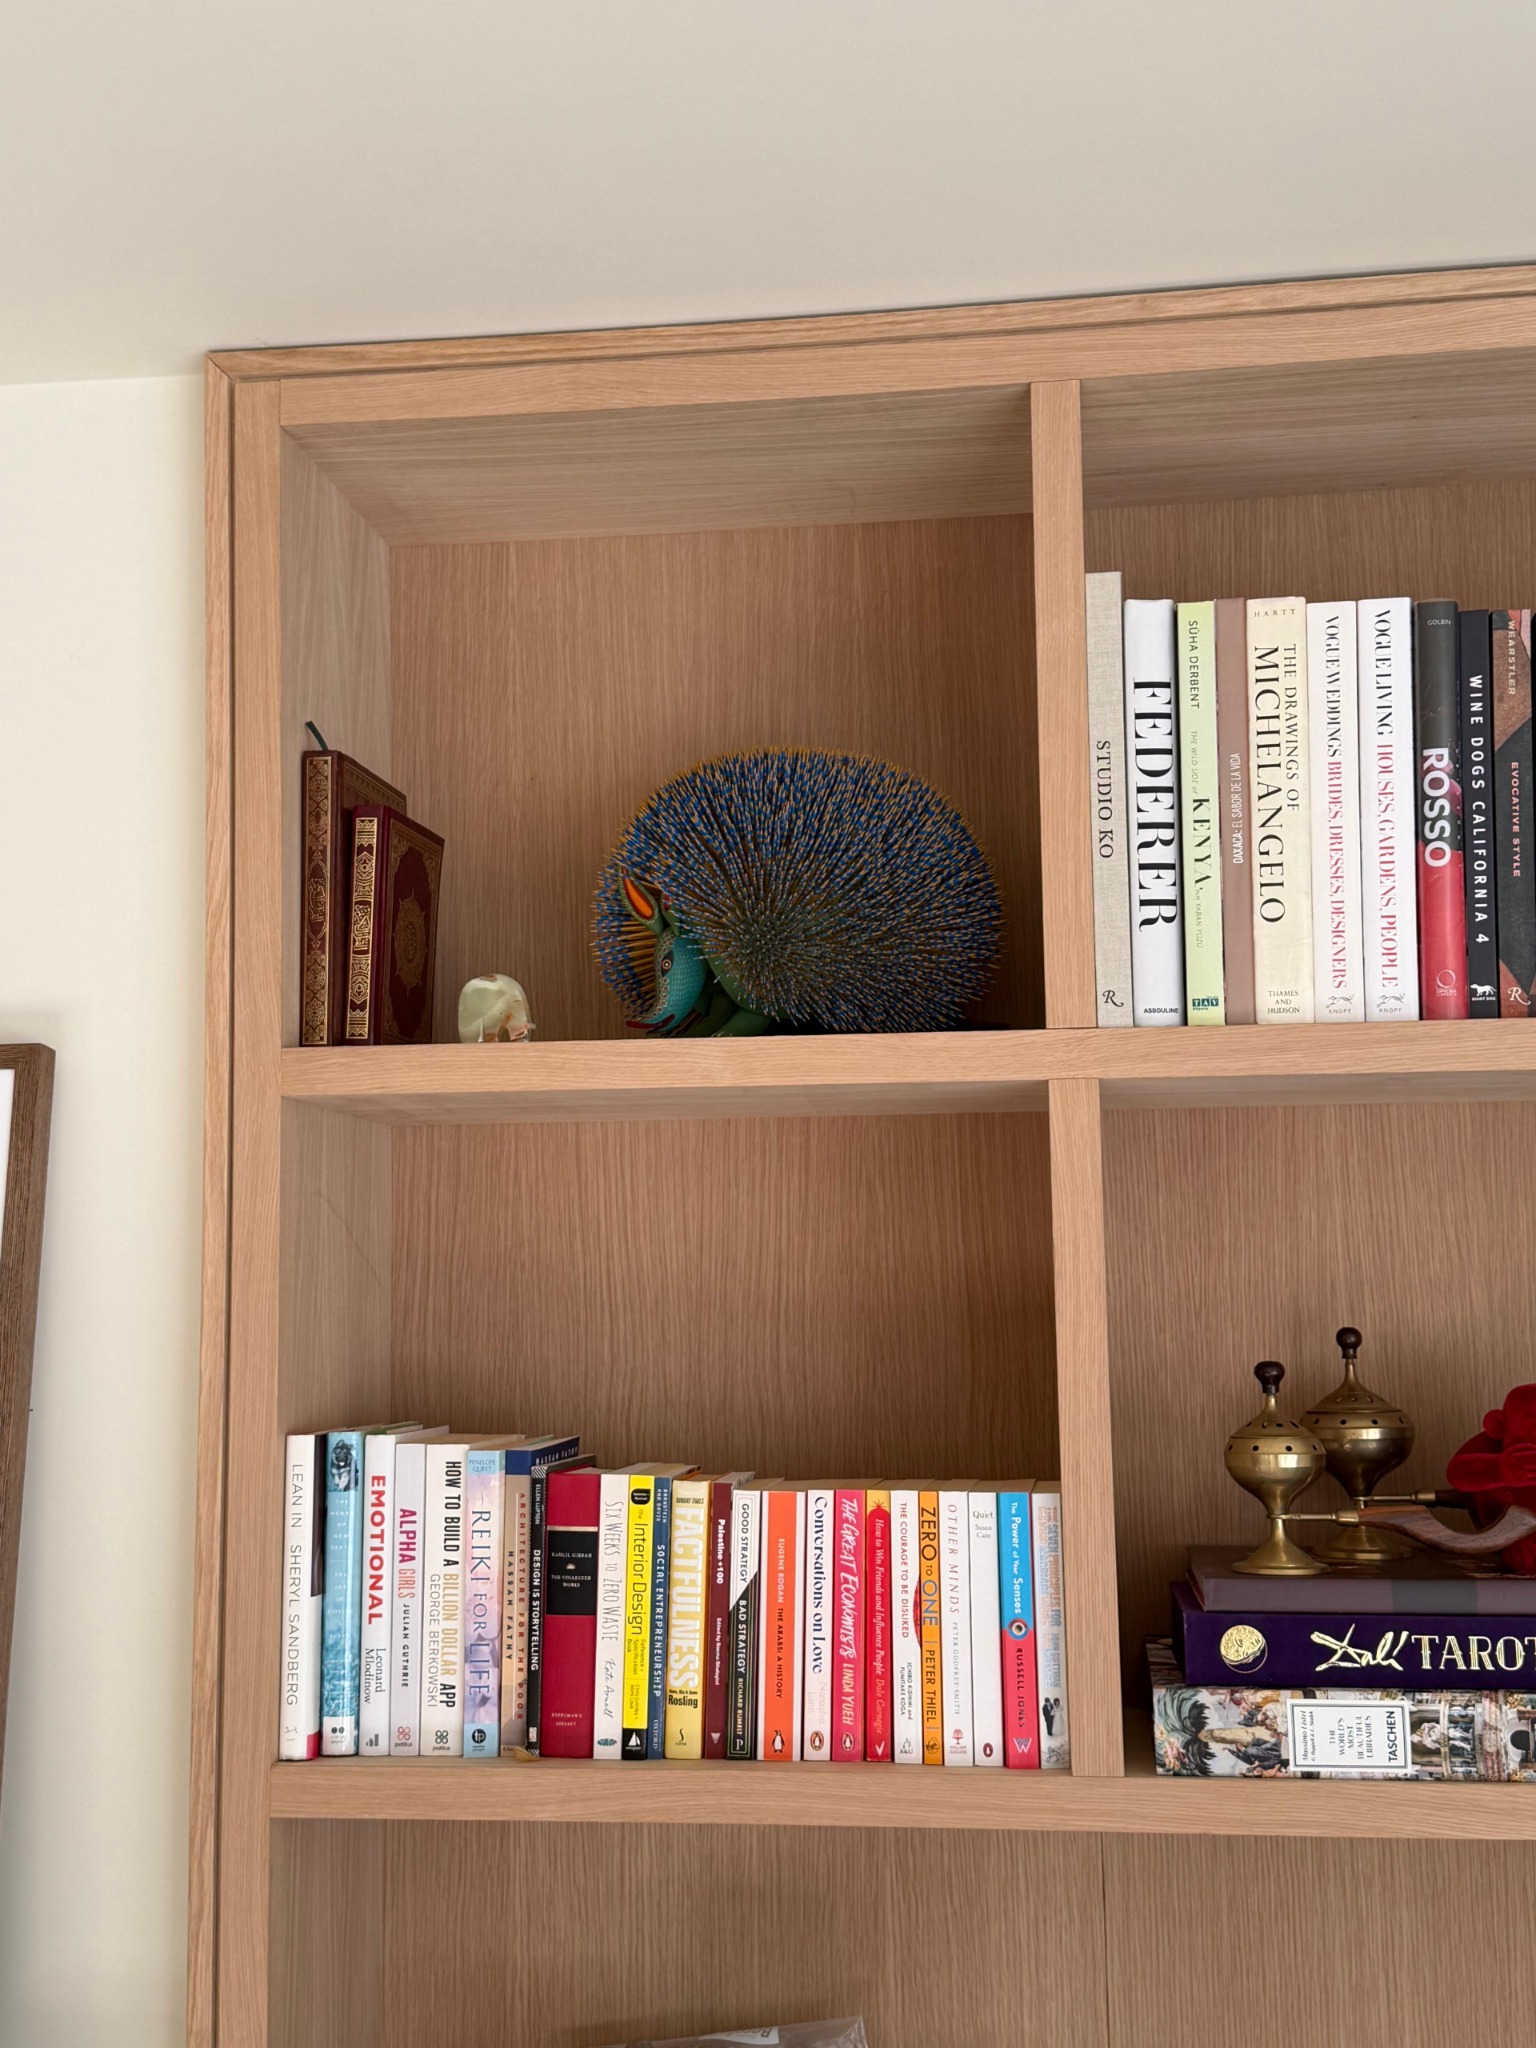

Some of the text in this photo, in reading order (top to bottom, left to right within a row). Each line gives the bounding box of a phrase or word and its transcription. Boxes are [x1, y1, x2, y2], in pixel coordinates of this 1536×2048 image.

[1188, 620, 1200, 709] SÜHA DERBENT
[1506, 620, 1516, 696] WEARSTLER
[1283, 644, 1300, 811] THE DRAWINGS OF
[1096, 740, 1114, 859] STUDIO KO
[1132, 677, 1178, 932] FEDERER
[1229, 752, 1244, 864] OAXACA: EL SABOR DE LA VIDA
[1254, 645, 1286, 923] MICHELANGELO
[1324, 615, 1347, 989] VOGUE WEDDINGS BRIDES, DRESSES, DESIGNERS
[1373, 609, 1398, 988] VOGUE LIVING HOUSES, GARDENS, PEOPLE
[1422, 747, 1452, 868] ROSSO
[1469, 675, 1489, 943] WINE DOGS CALIFORNIA 4
[1511, 761, 1521, 877] EVOCATIVE STYLE
[1267, 1006, 1300, 1014] HUDSON
[472, 1465, 493, 1473] QUEST
[367, 1475, 386, 1625] EMOTIONAL
[633, 1523, 648, 1579] Interior
[739, 1503, 750, 1583] GOOD STRATEGY
[777, 1538, 785, 1570] EUGENE
[947, 1503, 958, 1555] OTHER
[972, 1510, 994, 1520] Quiet
[1011, 1516, 1022, 1549] Power
[286, 1464, 303, 1706] LEAN IN SHERYL SANDBERG
[439, 1461, 462, 1708] HOW TO BUILD A BILLION DOLLAR APP
[532, 1550, 541, 1586] DESIGN
[532, 1588, 541, 1598] IS
[601, 1501, 624, 1641] SIX WEEKS TO ZERO WASTE
[777, 1572, 785, 1603] ROGAN
[811, 1496, 828, 1674] Conversations on Love
[899, 1502, 910, 1639] THE COURAGE TO BE DISLIKED
[948, 1563, 960, 1614] MINDS
[1013, 1551, 1020, 1559] of
[397, 1508, 417, 1687] ALPHA GIRLS JULIAN GUTHRIE
[469, 1510, 492, 1696] REIKI FOR LIFE
[505, 1550, 514, 1660] HASSAN FATHY
[516, 1493, 526, 1719] ARCHITECTURE FOR THE POOR
[627, 1582, 647, 1635] Design
[652, 1544, 666, 1698] SOCIAL ENTREPRENEURSHIP
[669, 1507, 705, 1688] FACTFULNESS
[738, 1600, 747, 1621] BAD
[872, 1518, 885, 1734] How to Win Friends and Influence People Dale Carnegie
[920, 1506, 938, 1723] ZERO TO ONE PETER THIEL
[1013, 1577, 1024, 1614] Senses
[375, 1647, 387, 1693] Leonard
[427, 1574, 441, 1707] GEORGE BERKOWSKI
[530, 1601, 541, 1671] STORYTELLING
[736, 1624, 747, 1674] STRATEGY
[776, 1624, 784, 1653] ARABS:
[364, 1647, 375, 1704] Mlodinow
[668, 1694, 698, 1709] Rosling
[736, 1678, 744, 1708] RICHARD
[775, 1664, 783, 1699] HISTORY
[1015, 1647, 1026, 1728] RUSSELL JONES
[1346, 1725, 1354, 1749] MOST
[1355, 1715, 1364, 1759] BEAUTIFUL
[1364, 1715, 1374, 1758] LIBRARIES
[1385, 1710, 1398, 1763] TASCHEN
